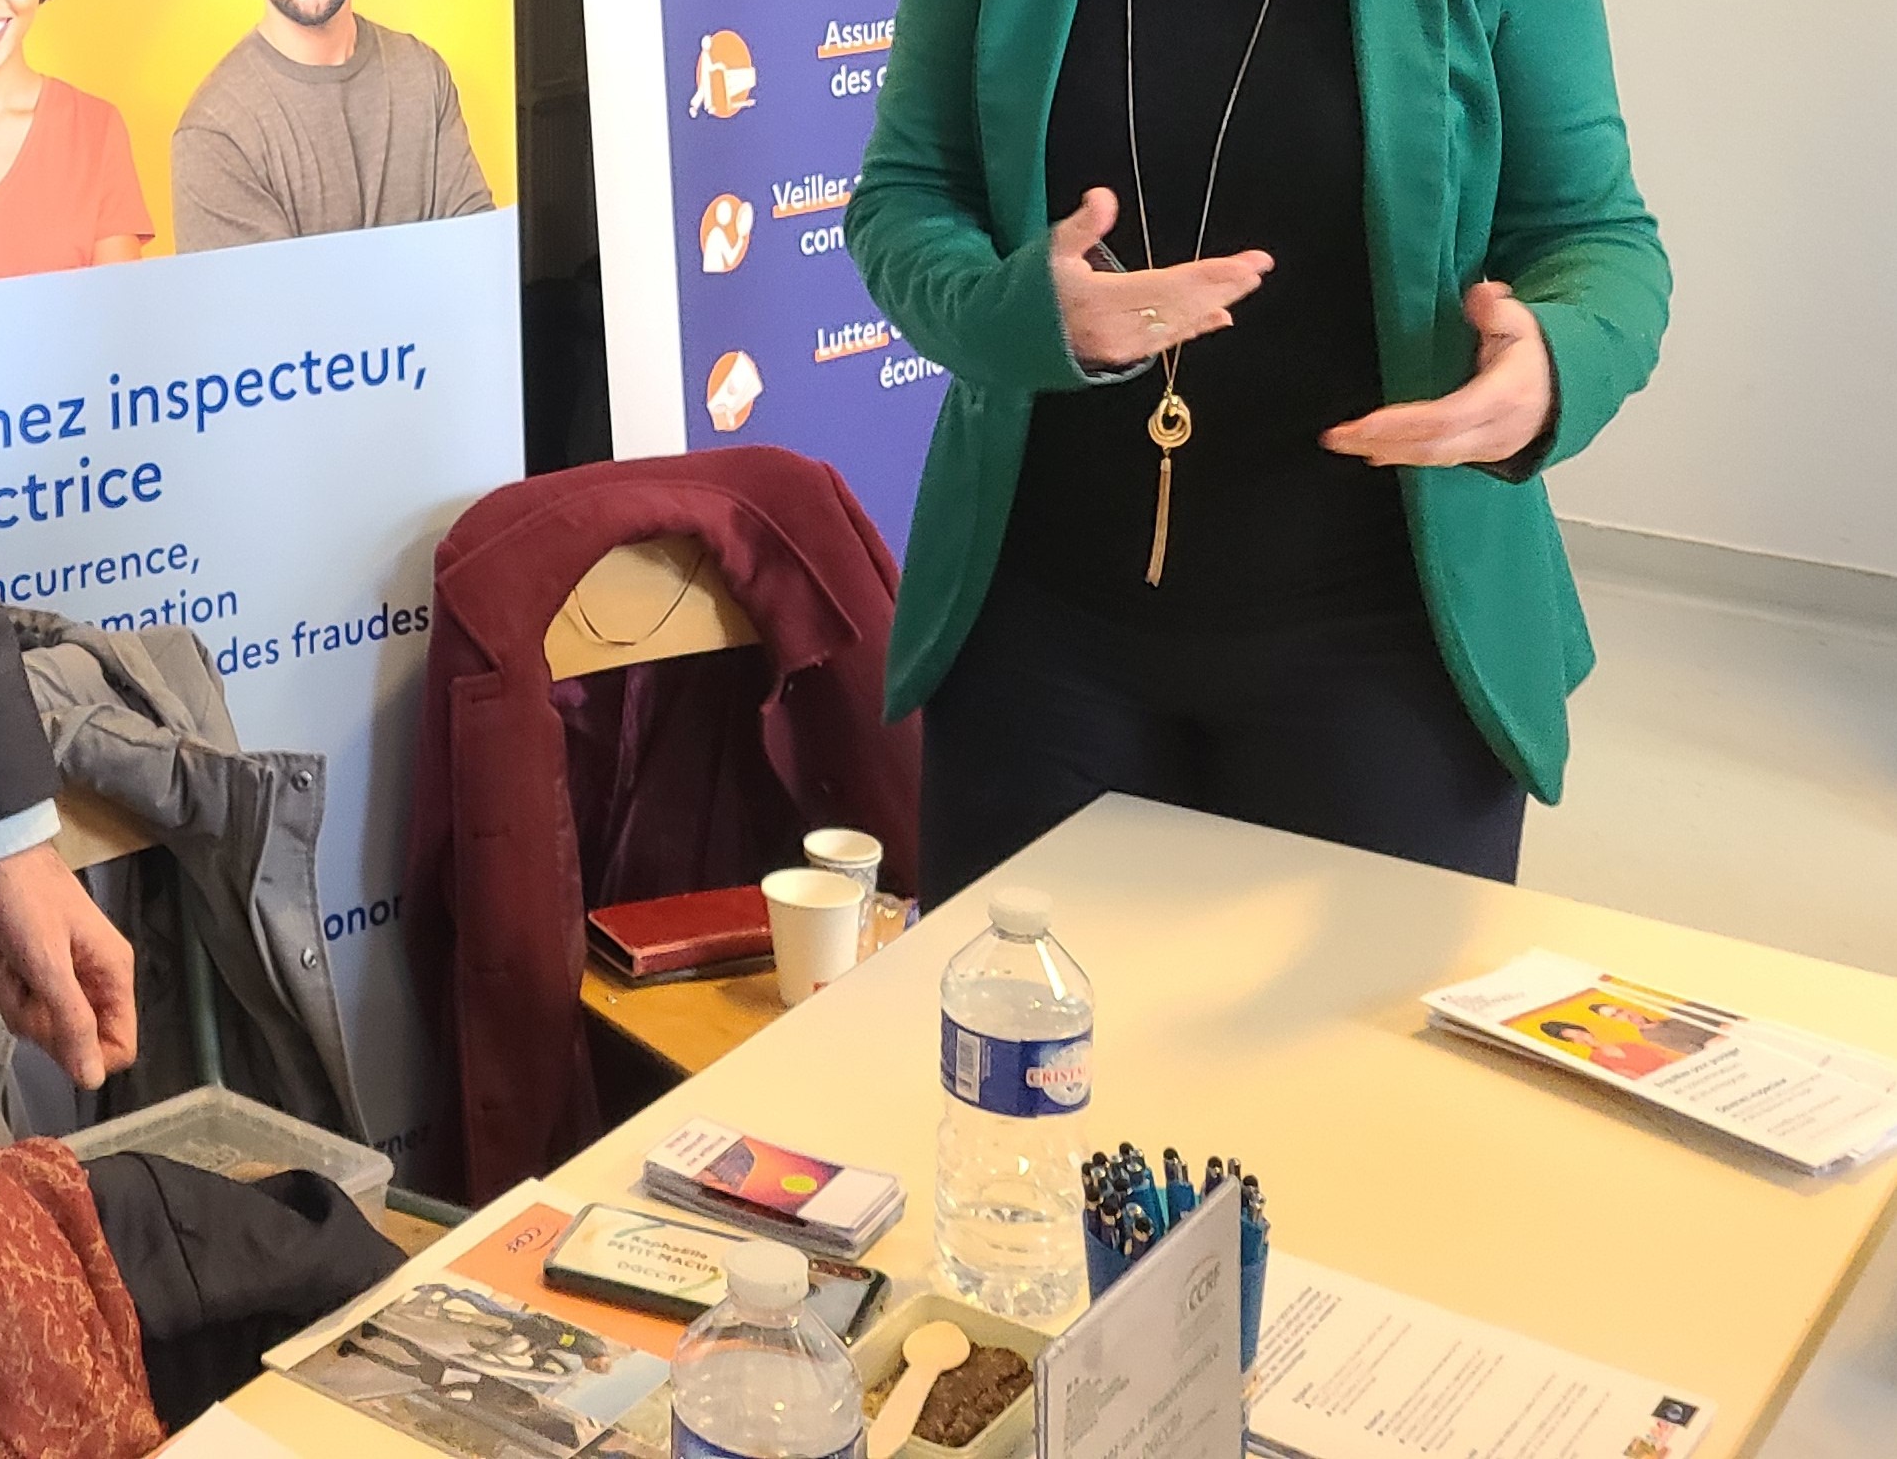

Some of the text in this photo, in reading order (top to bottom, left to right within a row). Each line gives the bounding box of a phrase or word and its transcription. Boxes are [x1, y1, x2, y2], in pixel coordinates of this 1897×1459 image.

[831, 64, 871, 97] des
[772, 174, 848, 211] Veiller
[817, 320, 886, 356] Lutter
[110, 343, 427, 433] inspecteur,
[86, 589, 238, 633] mation
[217, 602, 429, 676] des fraudes
